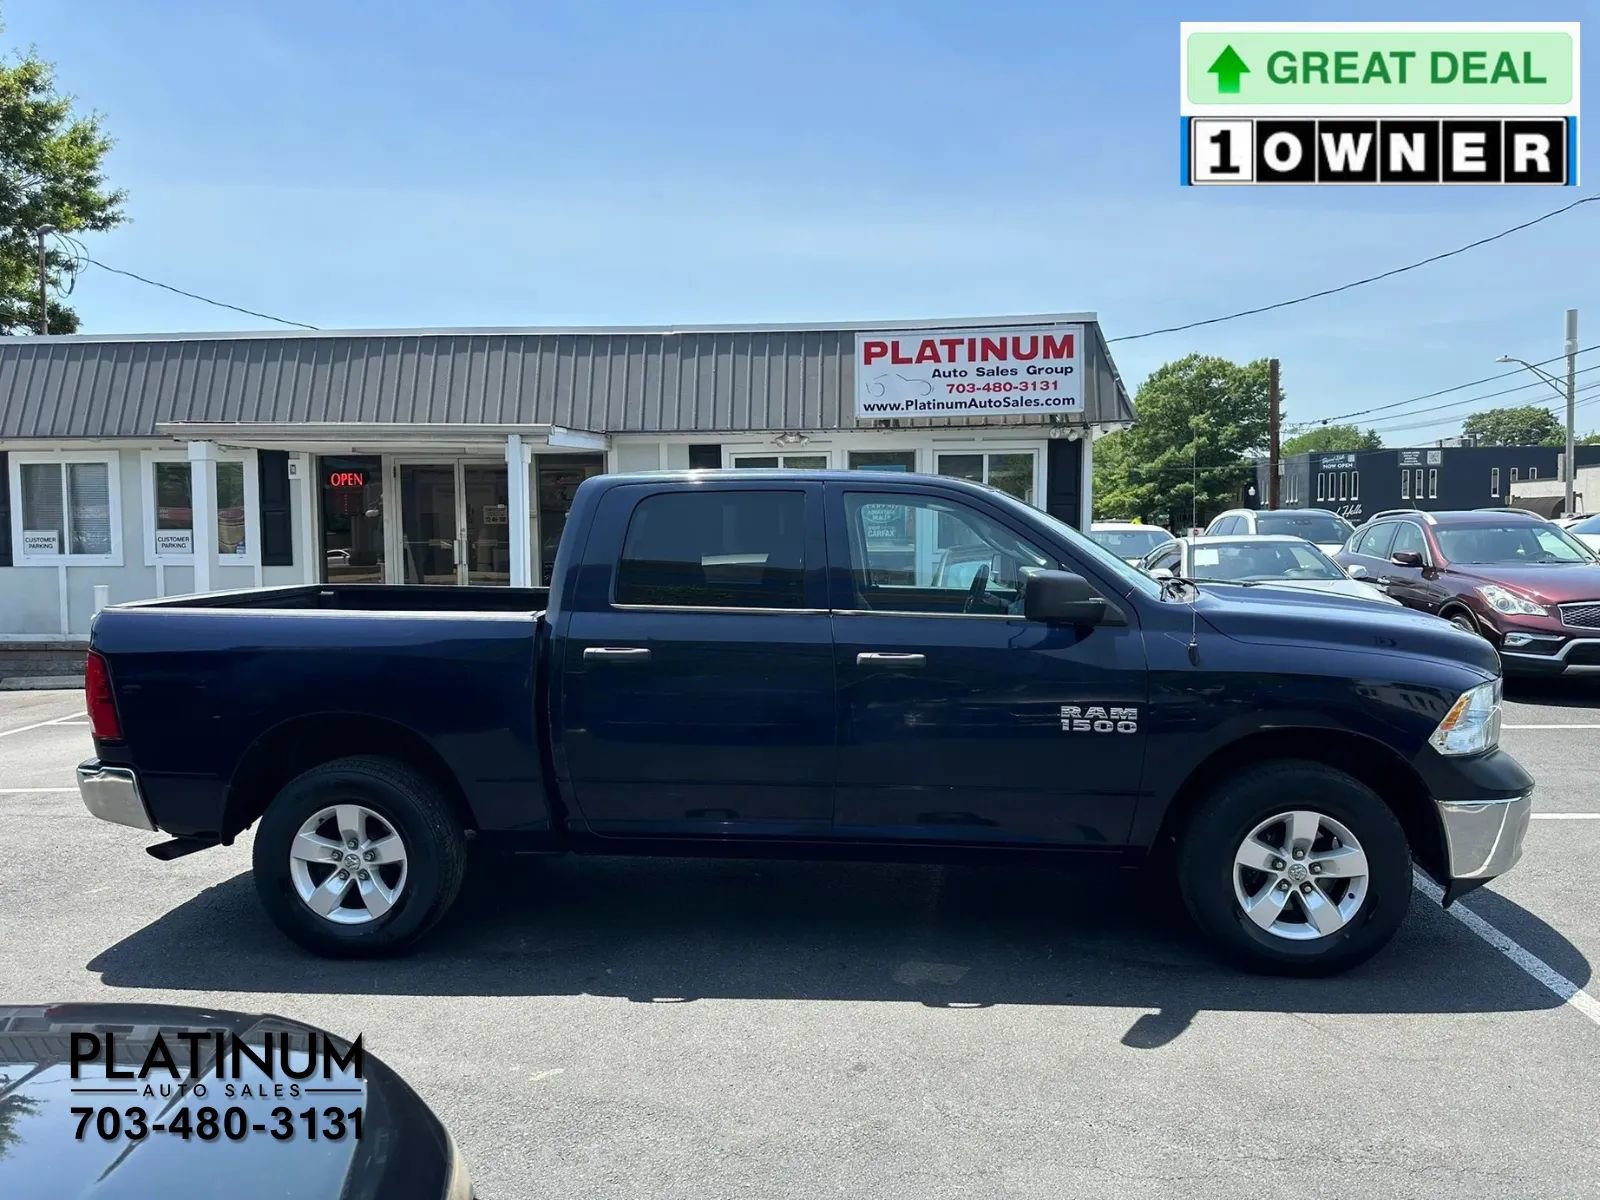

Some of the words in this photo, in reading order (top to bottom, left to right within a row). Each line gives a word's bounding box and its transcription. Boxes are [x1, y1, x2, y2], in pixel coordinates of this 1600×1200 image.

[863, 334, 1074, 366] PLATINUM
[931, 368, 968, 378] Auto
[975, 366, 1018, 377] Sales
[1026, 365, 1074, 376] Group
[946, 380, 1058, 394] 703-480-3131
[863, 395, 1076, 412] www.PlatinumAutoSales.com
[330, 472, 363, 487] OPEN
[1341, 503, 1362, 517] Hello
[1060, 705, 1138, 720] RAM
[1060, 719, 1137, 733] 1500
